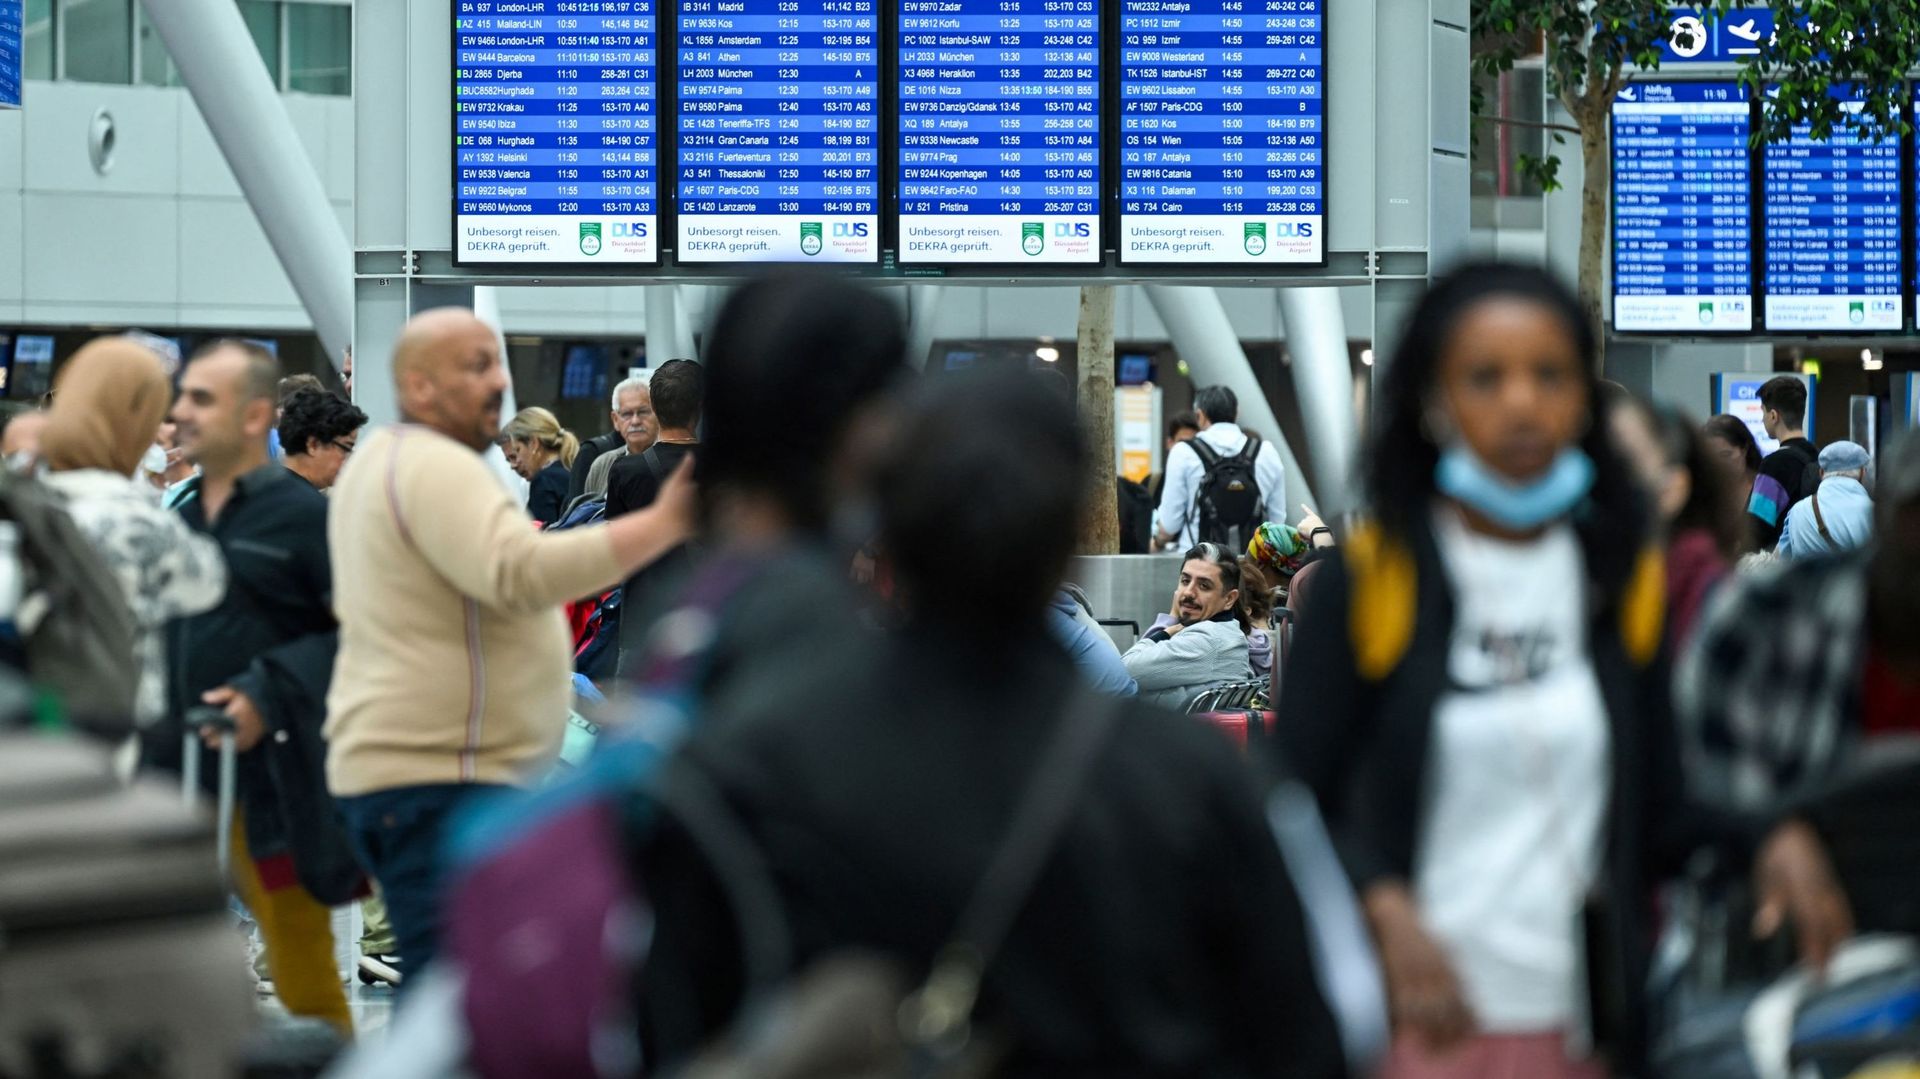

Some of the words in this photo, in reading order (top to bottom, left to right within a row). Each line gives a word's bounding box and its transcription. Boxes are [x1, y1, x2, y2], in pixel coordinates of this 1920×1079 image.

[684, 2, 691, 11] IB
[693, 2, 710, 11] 3141
[718, 2, 744, 11] Madrid
[779, 2, 798, 11] 12:05
[823, 2, 851, 11] 141,142
[856, 2, 870, 11] B23
[905, 2, 918, 11] EW
[919, 2, 938, 11] 9970
[939, 2, 962, 11] Zadar
[1000, 2, 1020, 11] 13:15
[1044, 2, 1073, 11] 153-170
[1077, 2, 1092, 11] C53
[1161, 2, 1190, 13] Antalya
[1222, 2, 1242, 11] 14:45
[1266, 1, 1296, 11] 240-242
[1299, 1, 1315, 11] C46
[905, 35, 916, 45] PC
[919, 35, 936, 45] 1002
[940, 35, 991, 45] Istanbul-SAW
[1000, 35, 1020, 45] 13:25
[1077, 35, 1092, 45] C42
[1127, 35, 1139, 44] XQ
[1143, 35, 1156, 45] 959
[1162, 36, 1180, 44] Izmir
[1222, 35, 1242, 45] 14:55
[1300, 35, 1315, 45] C42
[463, 69, 472, 78] BJ
[497, 69, 522, 80] Djerba
[558, 69, 577, 79] 11:10
[634, 69, 648, 79] C31
[684, 69, 694, 78] LH
[696, 69, 714, 78] 2003
[718, 69, 753, 78] München
[779, 69, 798, 78] 12:30
[856, 70, 861, 78] A
[1703, 89, 1727, 100] 11:10
[463, 103, 476, 112] EW
[478, 103, 496, 112] 9732
[498, 103, 524, 112] Krakau
[558, 102, 577, 112] 11:25
[602, 102, 631, 112] 153-170
[634, 102, 649, 112] A40
[1127, 102, 1137, 111] AF
[1140, 102, 1157, 111] 1507
[1162, 102, 1203, 112] Paris-CDG
[1223, 102, 1242, 111] 15:00
[1300, 102, 1306, 111] B
[463, 136, 474, 145] DE
[498, 136, 534, 147] Hurghada
[558, 136, 577, 145] 11:35
[602, 136, 631, 145] 184-190
[634, 136, 649, 145] C57
[684, 135, 694, 145] X3
[696, 135, 714, 145] 2114
[718, 135, 737, 145] Gran
[739, 135, 769, 145] Canaria
[779, 136, 798, 145] 12:45
[856, 136, 869, 145] B31
[905, 135, 918, 145] EW
[920, 135, 938, 145] 9338
[940, 136, 979, 145] Newcastle
[1000, 136, 1020, 145] 13:55
[1045, 136, 1074, 145] 153-170
[1077, 136, 1092, 145] A84
[1127, 135, 1139, 145] OS
[1144, 136, 1157, 145] 154
[1162, 136, 1181, 145] Wien
[1223, 136, 1242, 145] 15:05
[1300, 136, 1315, 145] A50
[463, 169, 477, 178] EW
[478, 169, 496, 178] 9538
[498, 170, 530, 179] Valencia
[558, 169, 577, 178] 11:50
[602, 169, 631, 179] 153-170
[635, 169, 648, 178] A31
[684, 169, 694, 178] A3
[698, 169, 710, 178] 541
[719, 169, 765, 178] Thessaloniki
[779, 169, 799, 178] 12:50
[823, 169, 852, 178] 145-150
[856, 169, 870, 178] B77
[905, 169, 919, 178] EW
[920, 169, 938, 178] 9244
[940, 169, 987, 180] Kopenhagen
[1001, 169, 1020, 178] 14:05
[1045, 169, 1074, 178] 153-170
[1077, 169, 1092, 178] A50
[463, 202, 477, 212] EW
[498, 203, 532, 213] Mykonos
[558, 202, 578, 212] 12:00
[602, 202, 631, 212] 153-170
[635, 202, 649, 212] A33
[684, 202, 695, 211] DE
[698, 202, 715, 211] 1420
[719, 203, 756, 212] Lanzarote
[779, 202, 799, 211] 13:00
[824, 202, 852, 212] 184-190
[856, 202, 870, 212] B79
[905, 203, 913, 211] IV
[917, 202, 930, 211] 521
[940, 202, 968, 212] Pristina
[1001, 202, 1020, 212] 14:30
[1045, 202, 1074, 212] 205-207
[1078, 202, 1092, 212] C31
[1127, 202, 1139, 212] MS
[1144, 202, 1157, 211] 734
[1162, 202, 1182, 212] Cairo
[1223, 203, 1243, 212] 15:15
[467, 226, 523, 238] Unbesorgt
[525, 226, 561, 237] reisen.
[612, 222, 647, 238] DUS
[687, 226, 743, 237] Unbesorgt
[746, 226, 781, 236] reisen.
[833, 222, 868, 237] DUS
[909, 226, 964, 237] Unbesorgt
[967, 226, 1003, 236] reisen.
[1055, 222, 1090, 238] DUS
[1131, 226, 1187, 237] Unbesorgt
[1189, 226, 1225, 236] reisen.
[1277, 222, 1312, 238] DUS
[467, 241, 506, 251] DEKRA
[508, 241, 550, 252] geprüft.
[687, 240, 726, 251] DEKRA
[728, 240, 771, 252] geprüft.
[909, 241, 948, 251] DEKRA
[950, 241, 992, 253] geprüft.
[1131, 241, 1170, 251] DEKRA
[1172, 241, 1214, 253] geprüft.
[380, 278, 390, 286] B1
